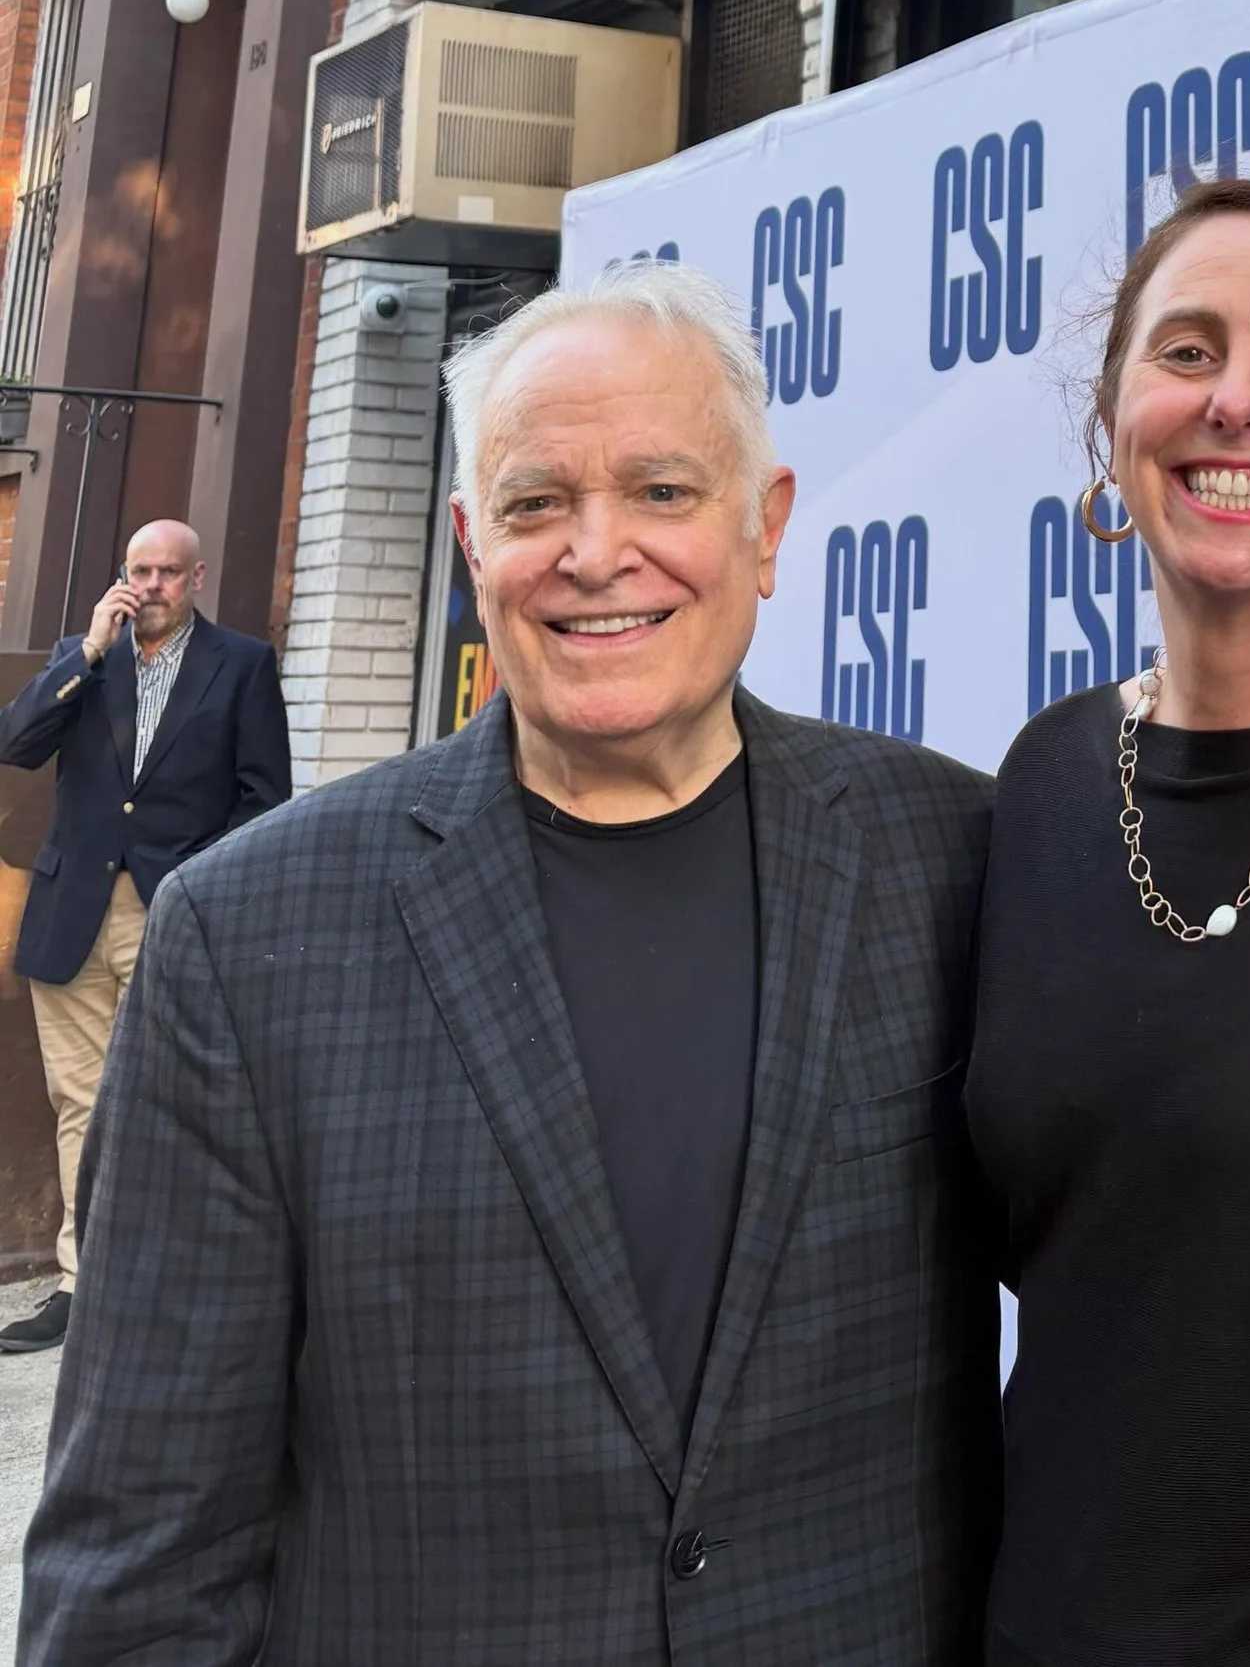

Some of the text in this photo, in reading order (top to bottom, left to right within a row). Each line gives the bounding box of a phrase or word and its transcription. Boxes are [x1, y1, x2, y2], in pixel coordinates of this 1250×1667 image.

[752, 186, 846, 406] CSC
[929, 119, 1044, 372] CSC
[821, 514, 929, 745] CSC
